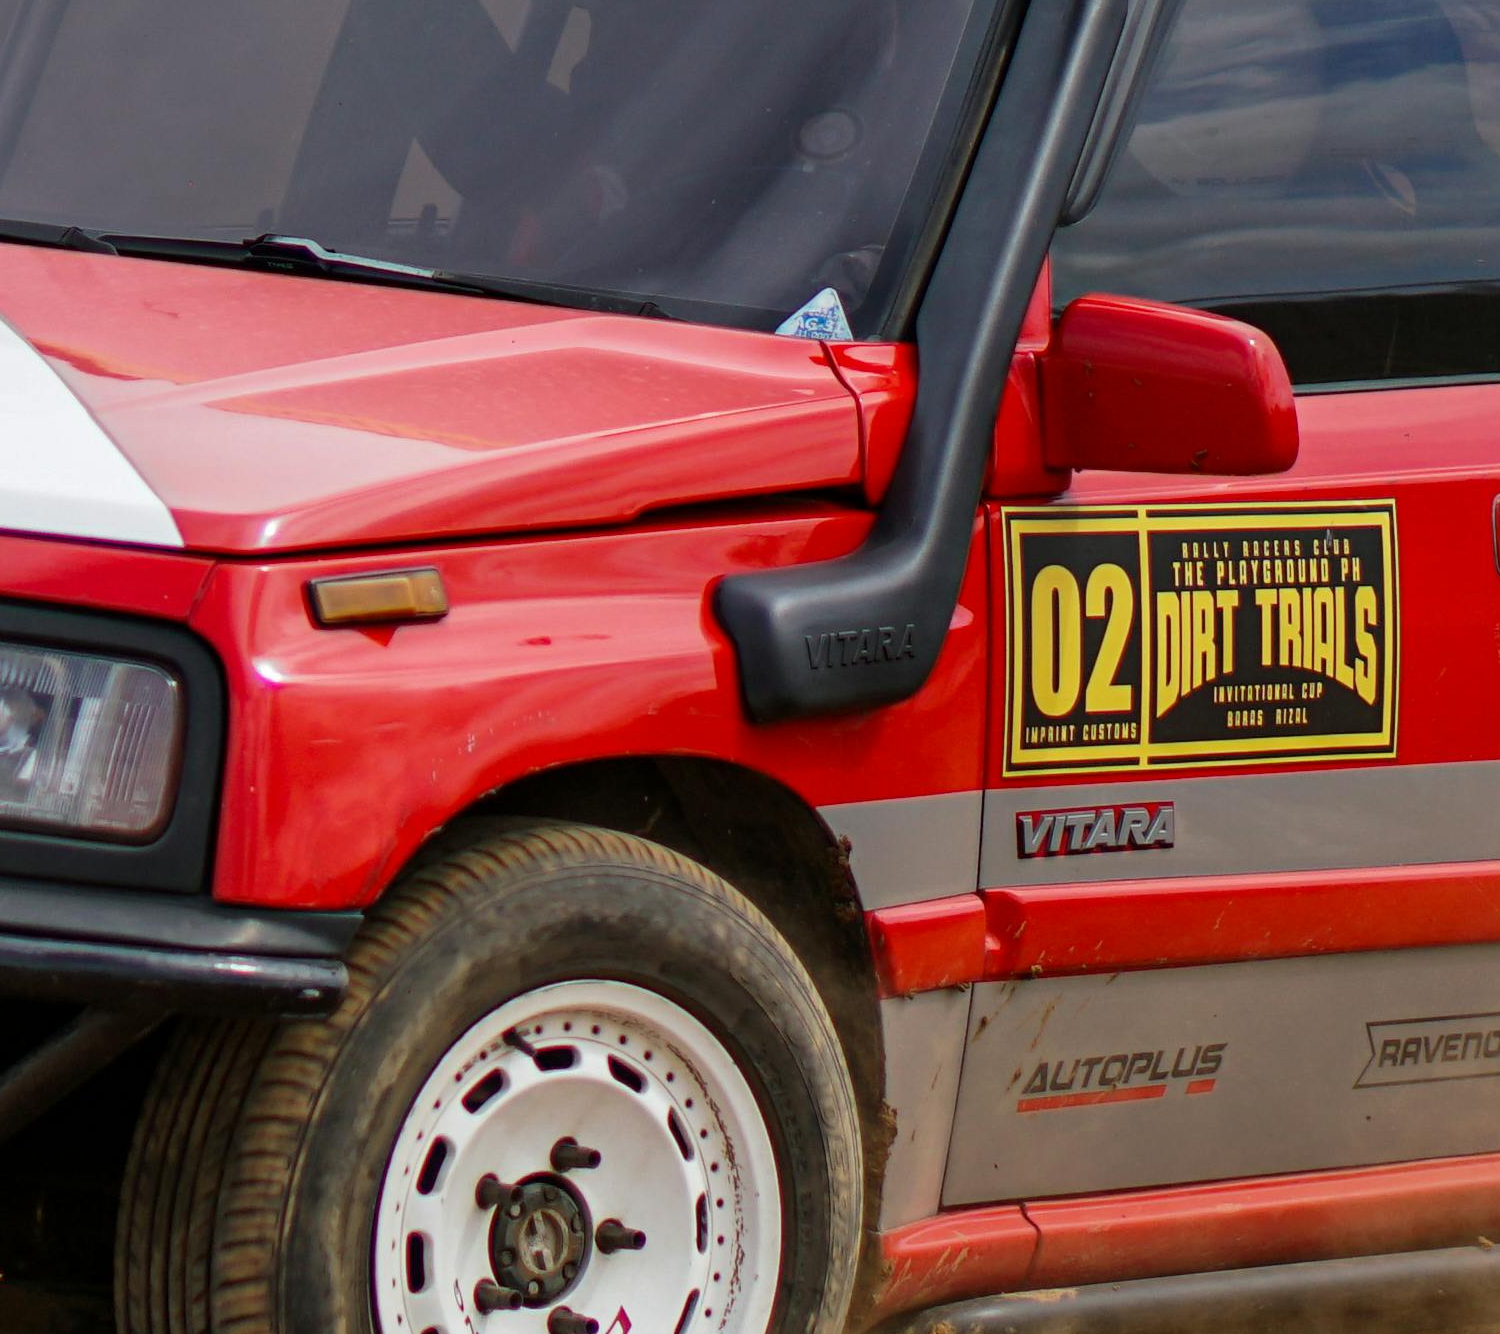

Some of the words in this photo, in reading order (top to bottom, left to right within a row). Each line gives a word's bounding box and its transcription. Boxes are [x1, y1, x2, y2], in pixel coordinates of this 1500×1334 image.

[1182, 542, 1229, 558] RALLY
[1243, 540, 1300, 557] RACERS
[1314, 539, 1350, 555] CLUB
[1173, 561, 1203, 586] THE
[1217, 558, 1328, 585] PLAYGROUND
[1341, 557, 1360, 581] PH
[805, 624, 916, 670] VITARA
[1031, 563, 1133, 716] 02
[1157, 589, 1238, 718] DIRT
[1255, 585, 1377, 706] TRIALS
[1214, 683, 1294, 703] INVITATIONAL
[1302, 682, 1323, 699] CUP
[1025, 724, 1075, 744] IMPRINT
[1082, 722, 1137, 741] CUSTOMS
[1276, 707, 1308, 725] RIZAL
[1018, 805, 1175, 857] VITARA
[1021, 1042, 1228, 1095] AUTOPLUS
